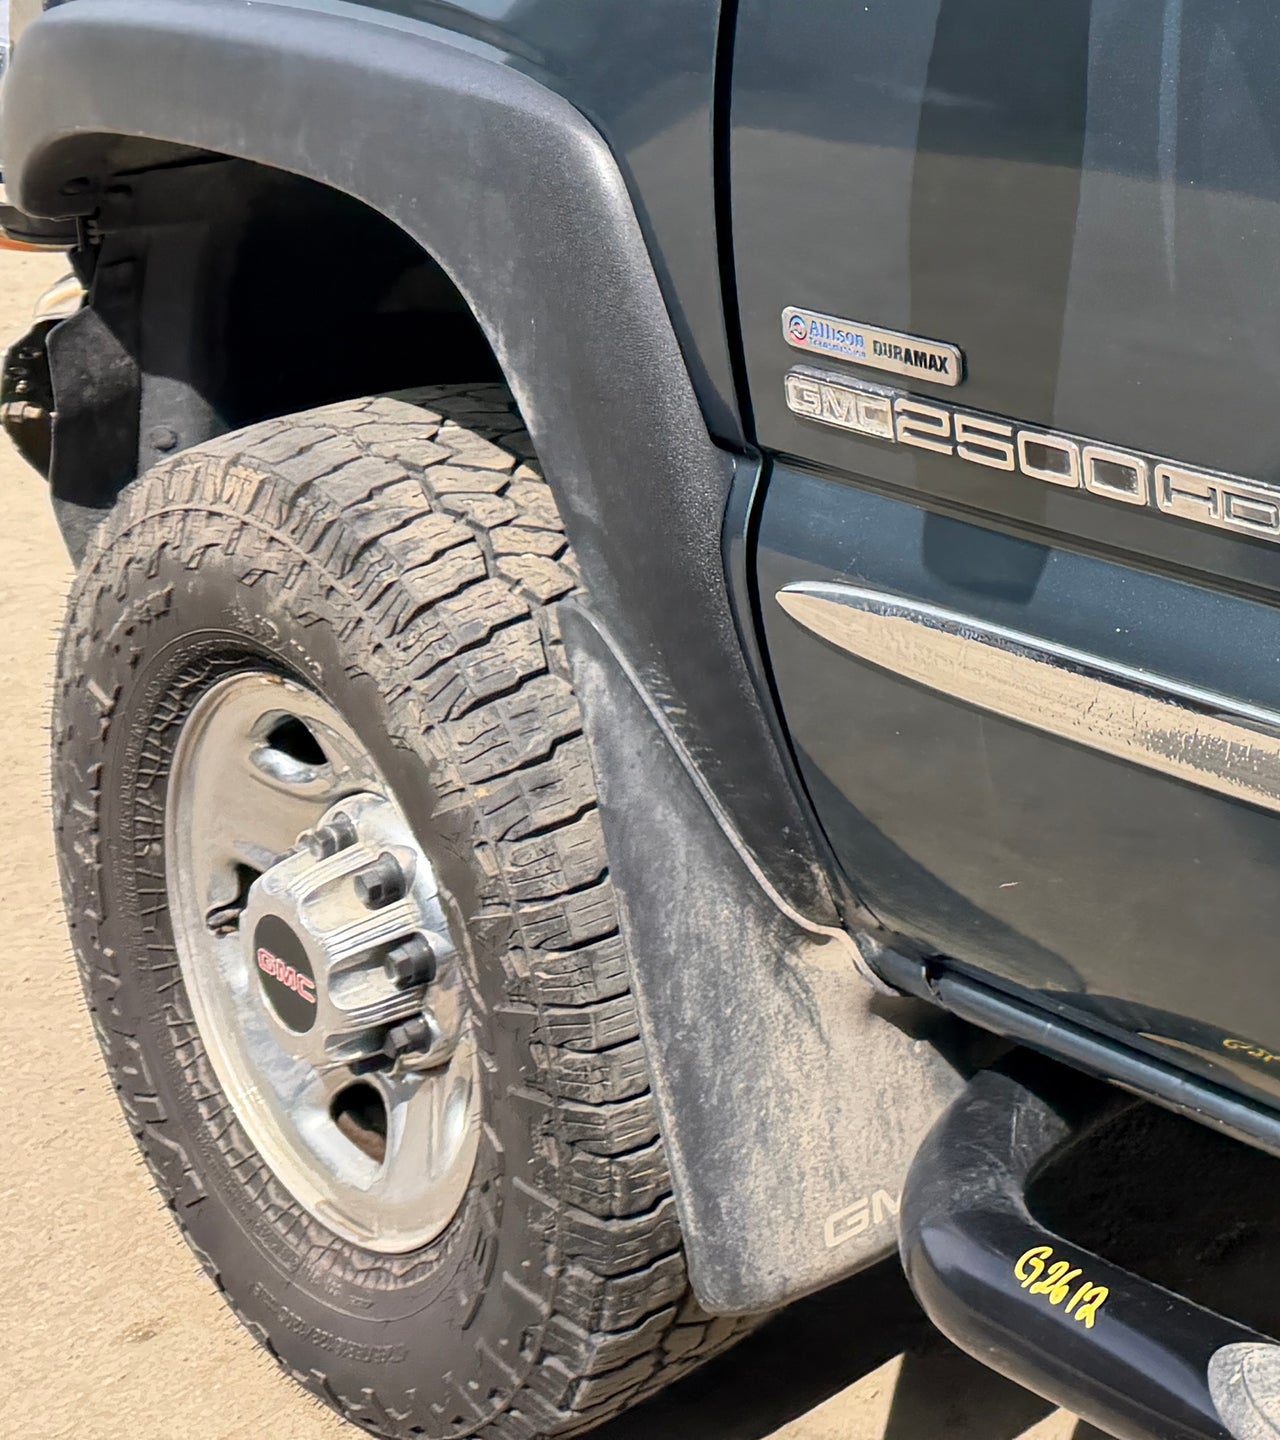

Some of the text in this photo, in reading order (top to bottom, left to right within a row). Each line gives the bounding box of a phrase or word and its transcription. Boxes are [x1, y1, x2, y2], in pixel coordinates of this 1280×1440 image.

[809, 320, 866, 348] Allison
[872, 339, 950, 375] DURAMAX
[787, 375, 891, 440] GMC
[894, 397, 1148, 506] 2500
[257, 947, 317, 1004] GMC
[822, 1189, 902, 1248] GM
[1013, 1245, 1110, 1329] G2612
